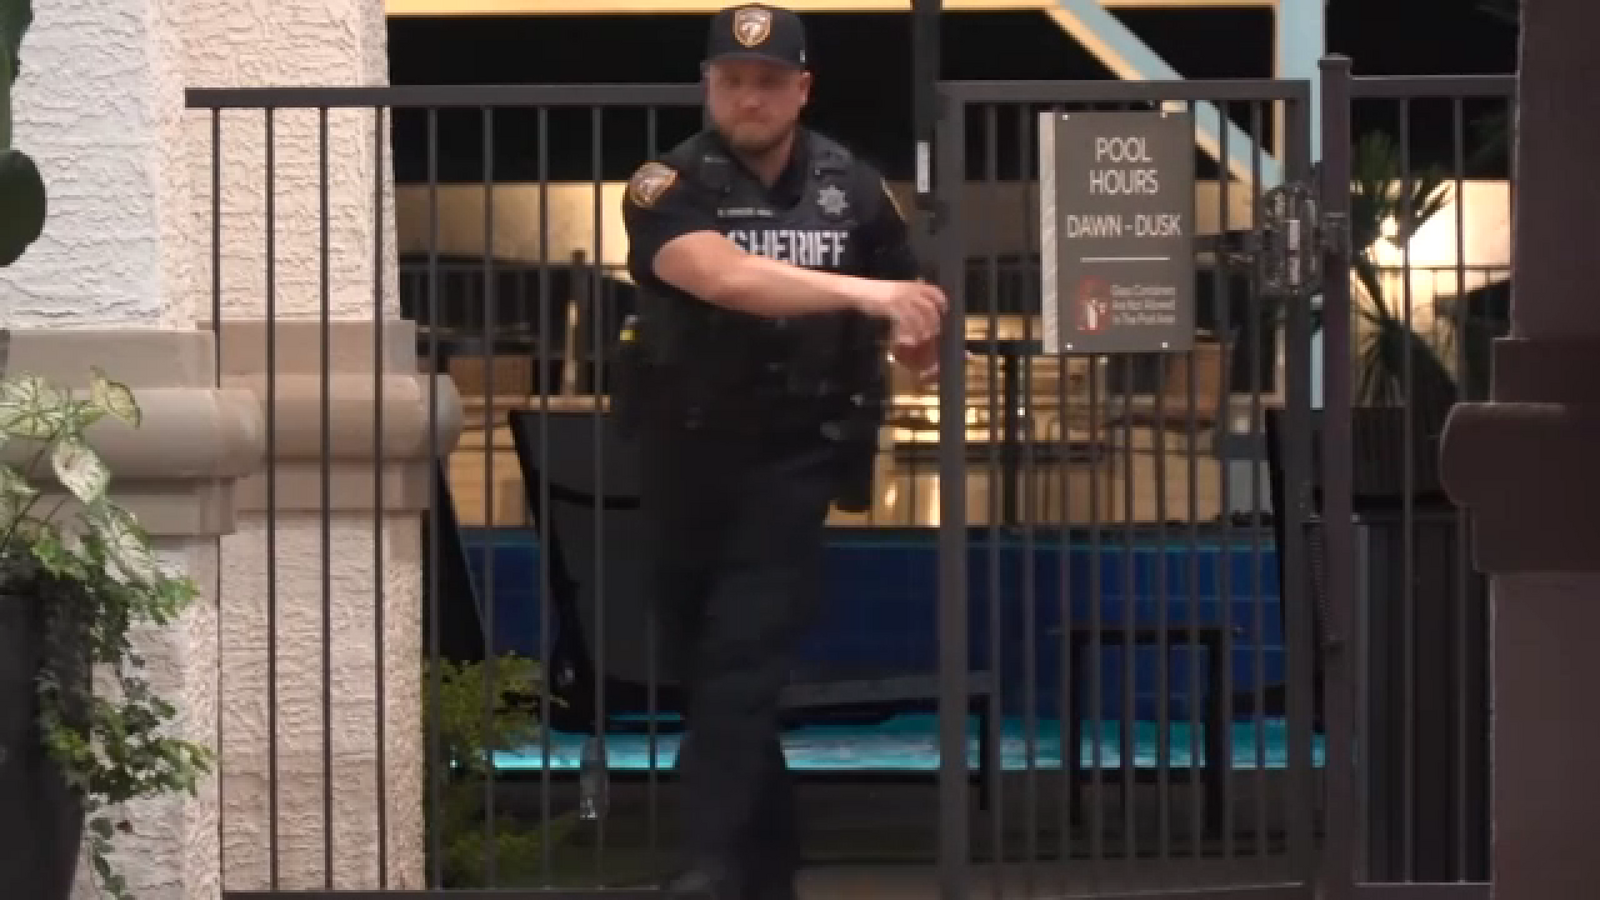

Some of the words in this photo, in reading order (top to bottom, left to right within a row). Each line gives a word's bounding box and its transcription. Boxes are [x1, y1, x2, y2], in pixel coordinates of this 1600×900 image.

[1095, 137, 1153, 163] POOL
[1089, 169, 1159, 195] HOURS
[1066, 214, 1122, 238] DAWN
[1134, 214, 1182, 236] DUSK
